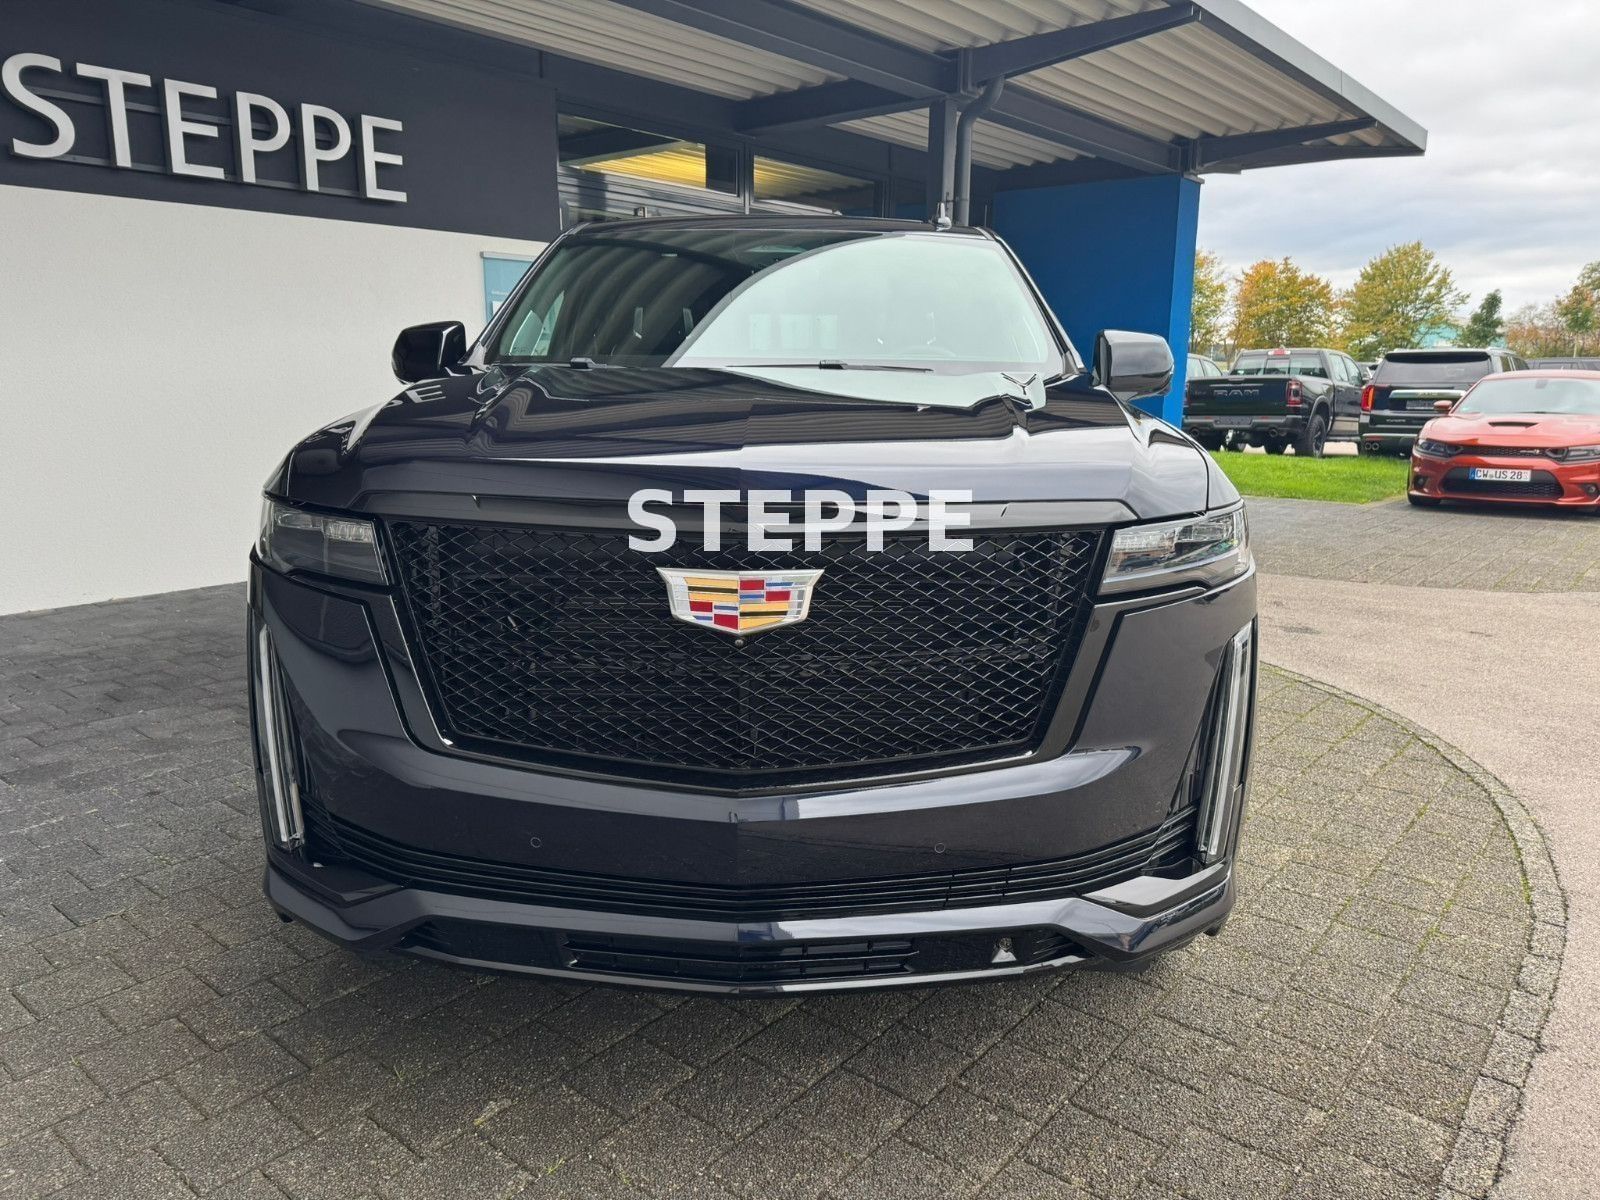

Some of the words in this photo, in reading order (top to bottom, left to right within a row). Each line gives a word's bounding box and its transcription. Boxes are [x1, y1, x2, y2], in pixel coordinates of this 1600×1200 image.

[2, 53, 407, 203] STEPPE
[1213, 389, 1259, 397] RAM
[1476, 468, 1489, 478] CW
